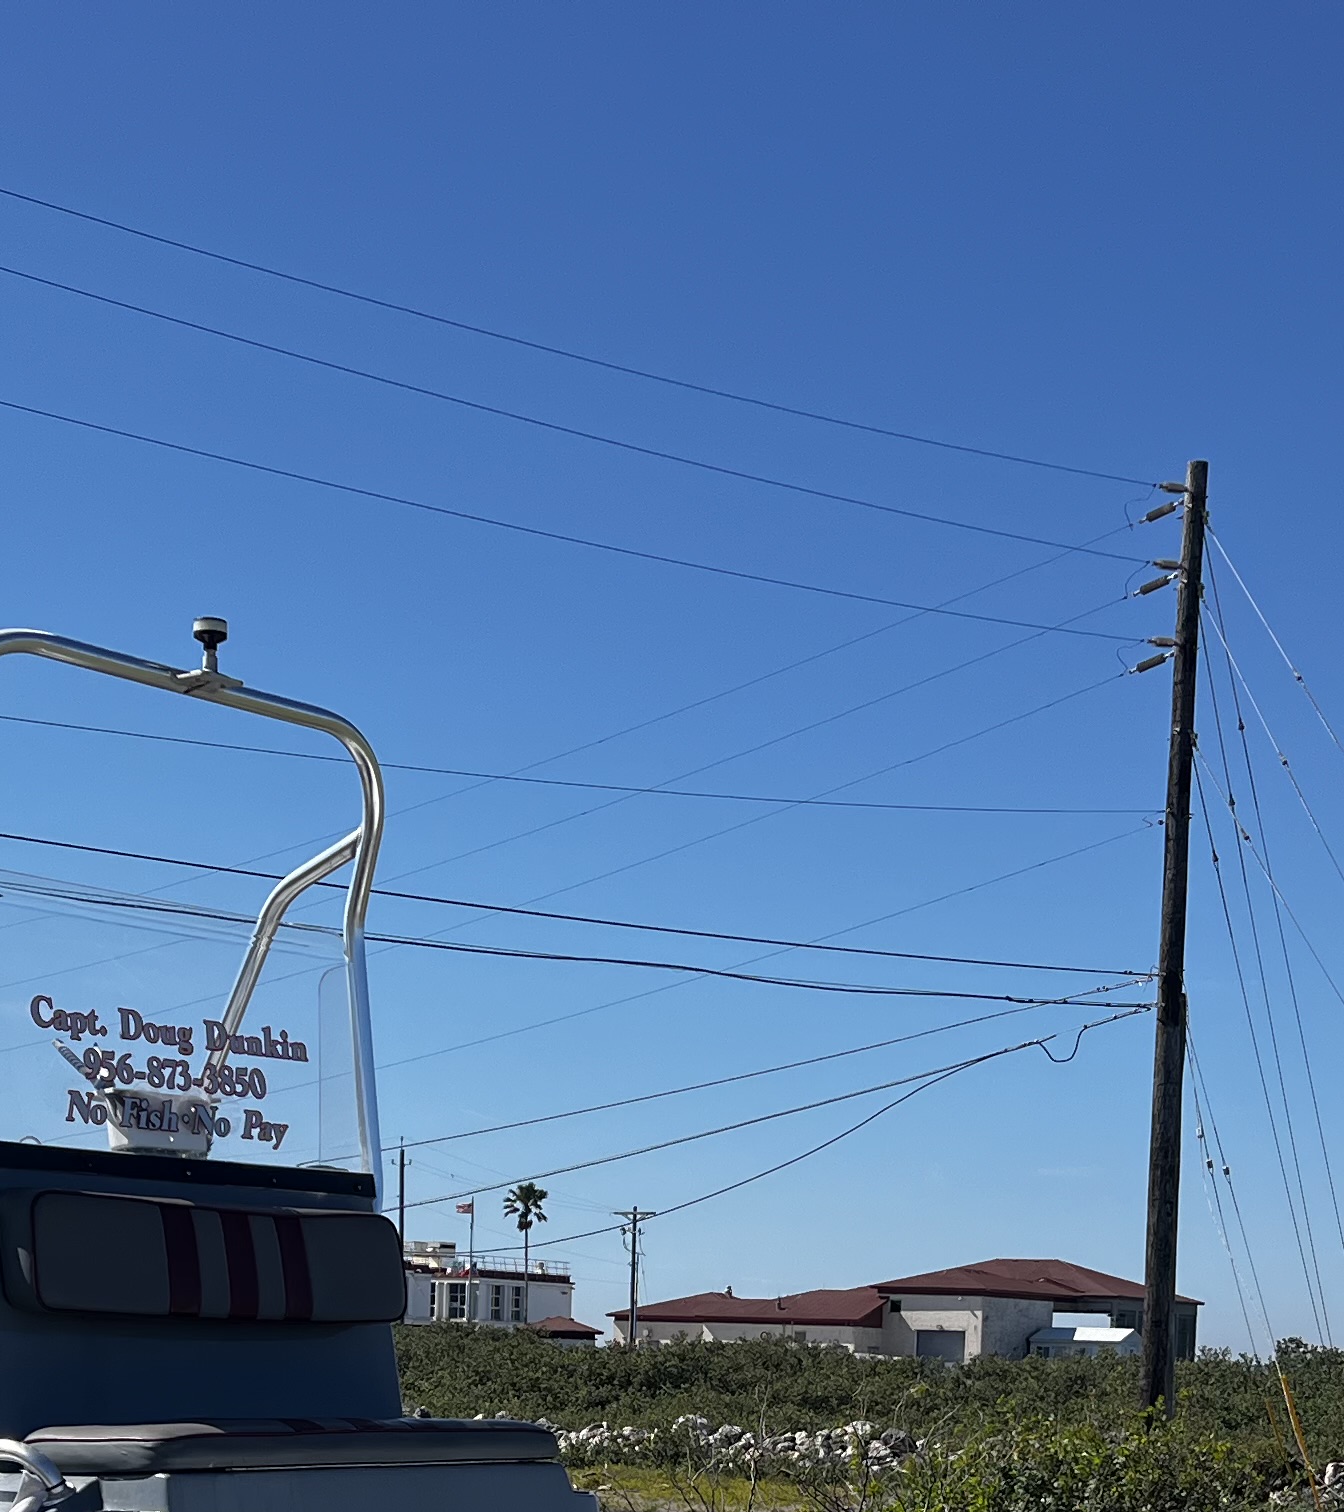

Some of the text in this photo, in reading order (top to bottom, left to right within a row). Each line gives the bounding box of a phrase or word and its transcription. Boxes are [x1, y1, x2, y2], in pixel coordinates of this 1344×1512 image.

[29, 994, 309, 1063] Capt. Doug Dunkin
[82, 1047, 267, 1100] 956-873-3850
[65, 1089, 107, 1126] No
[241, 1109, 289, 1150] Pay
